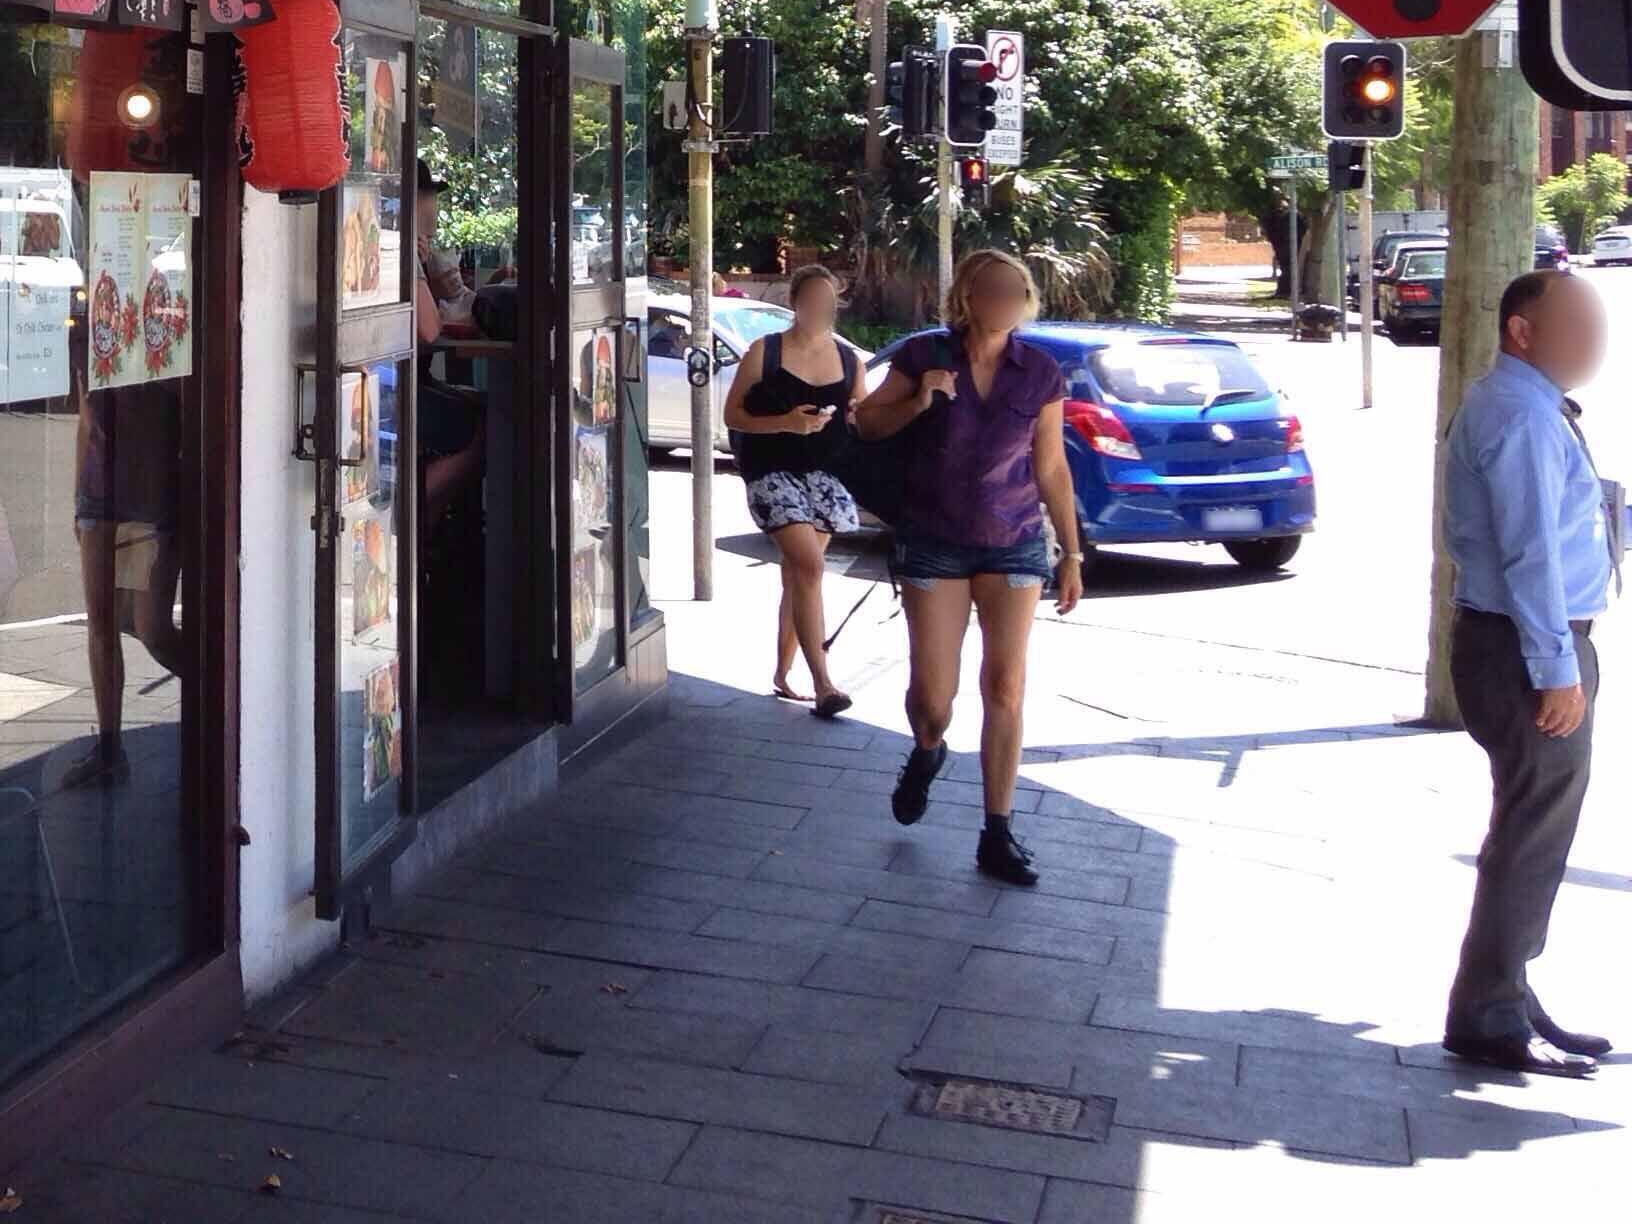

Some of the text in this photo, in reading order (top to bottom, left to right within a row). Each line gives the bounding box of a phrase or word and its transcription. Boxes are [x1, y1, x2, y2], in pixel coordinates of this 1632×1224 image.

[996, 87, 1014, 100] NO
[996, 119, 1018, 129] URN
[1273, 158, 1312, 169] ALISON
